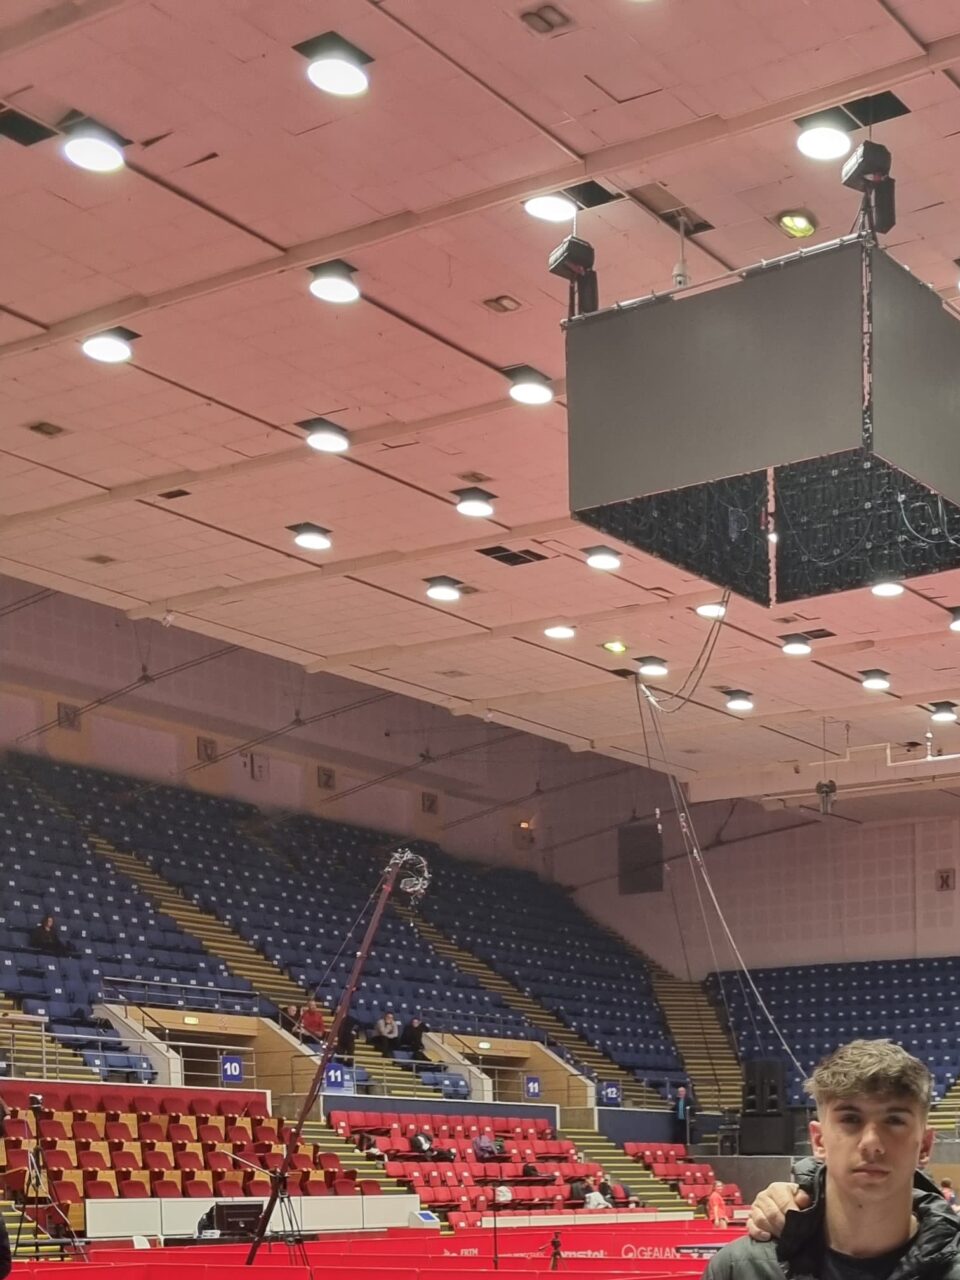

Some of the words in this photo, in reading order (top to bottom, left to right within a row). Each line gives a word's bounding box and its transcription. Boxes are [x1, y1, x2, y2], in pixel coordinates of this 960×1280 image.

[224, 1062, 240, 1075] 10
[328, 1070, 342, 1082] 11
[527, 1082, 539, 1093] 11
